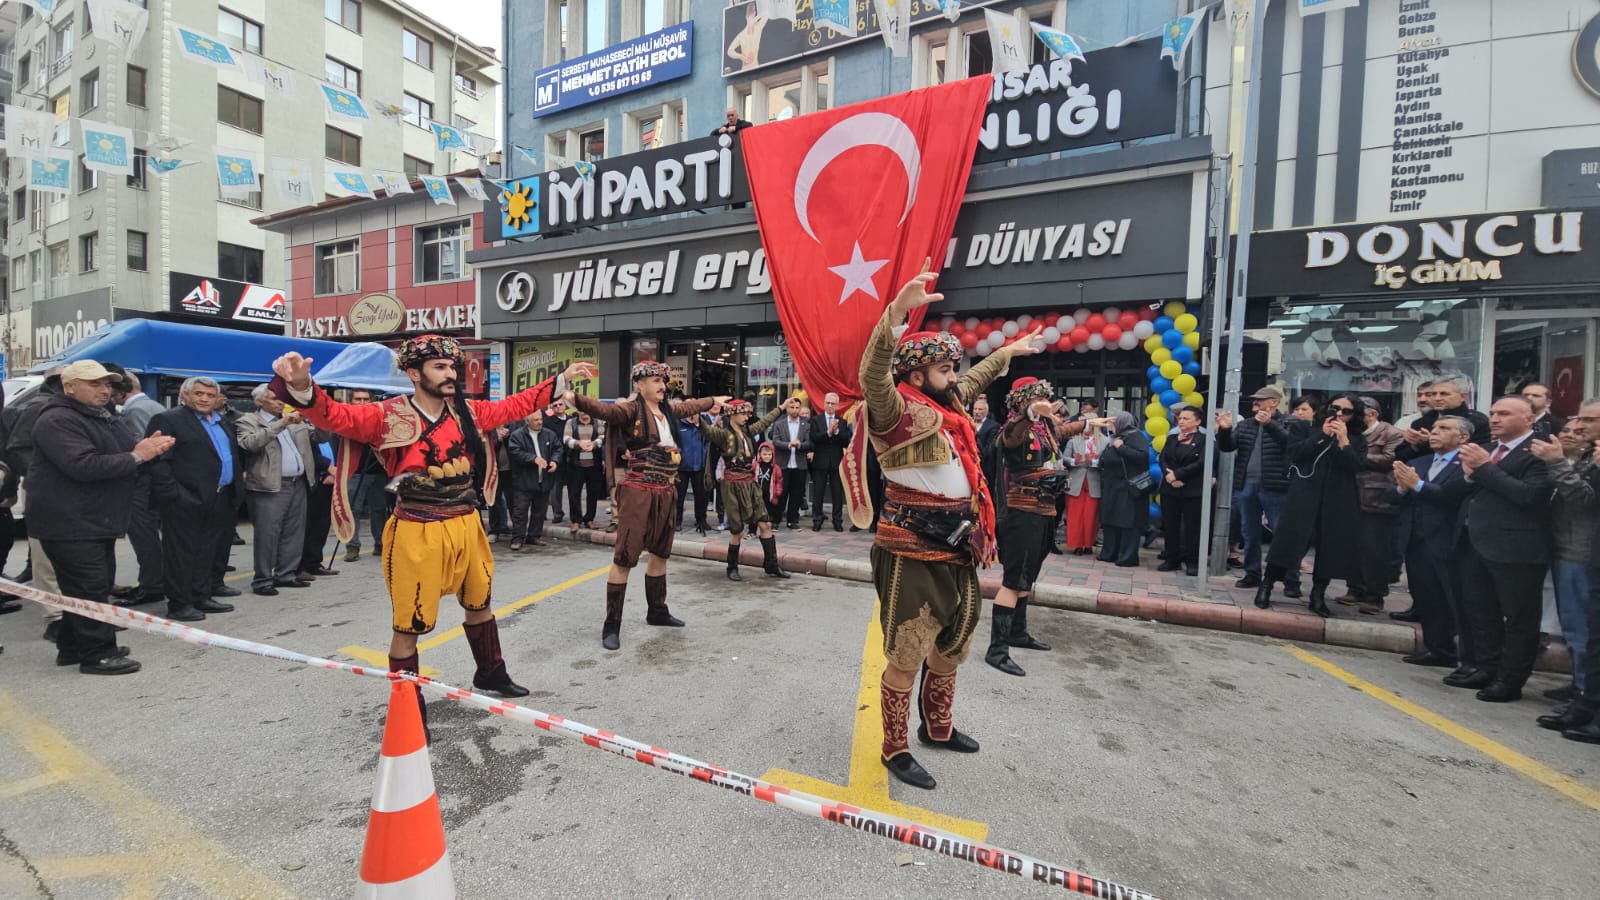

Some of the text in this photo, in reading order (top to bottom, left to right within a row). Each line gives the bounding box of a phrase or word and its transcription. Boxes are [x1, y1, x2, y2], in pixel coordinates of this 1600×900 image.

[1398, 11, 1436, 25] Gebze
[1398, 24, 1435, 38] Bursa
[560, 28, 688, 78] SERBEST MUHASEBECİ MALİ MÜŞAVİR
[1396, 48, 1450, 64] Kütahya
[561, 45, 686, 92] MEHMET FATİH EROL
[1396, 62, 1429, 77] Uşak
[1396, 73, 1440, 89] Denizli
[537, 84, 553, 106] M
[1395, 86, 1442, 102] Isparta
[1394, 100, 1431, 115] Aydın
[1394, 112, 1442, 126] Manisa
[1393, 121, 1464, 140] Çanakkale
[1392, 146, 1452, 163] Kırklareli
[1391, 164, 1431, 176] Konya
[548, 135, 733, 226] İYİ PARTİ
[1391, 173, 1464, 188] Kastamonu
[1390, 189, 1426, 201] Sinop
[1389, 200, 1421, 213] İzmir
[1305, 211, 1583, 269] DONCU
[547, 249, 680, 312] yüksel
[965, 218, 1131, 267] DÜNYASI
[1374, 257, 1502, 289] İÇ GİYİM
[295, 304, 476, 338] PASTA EKMEK
